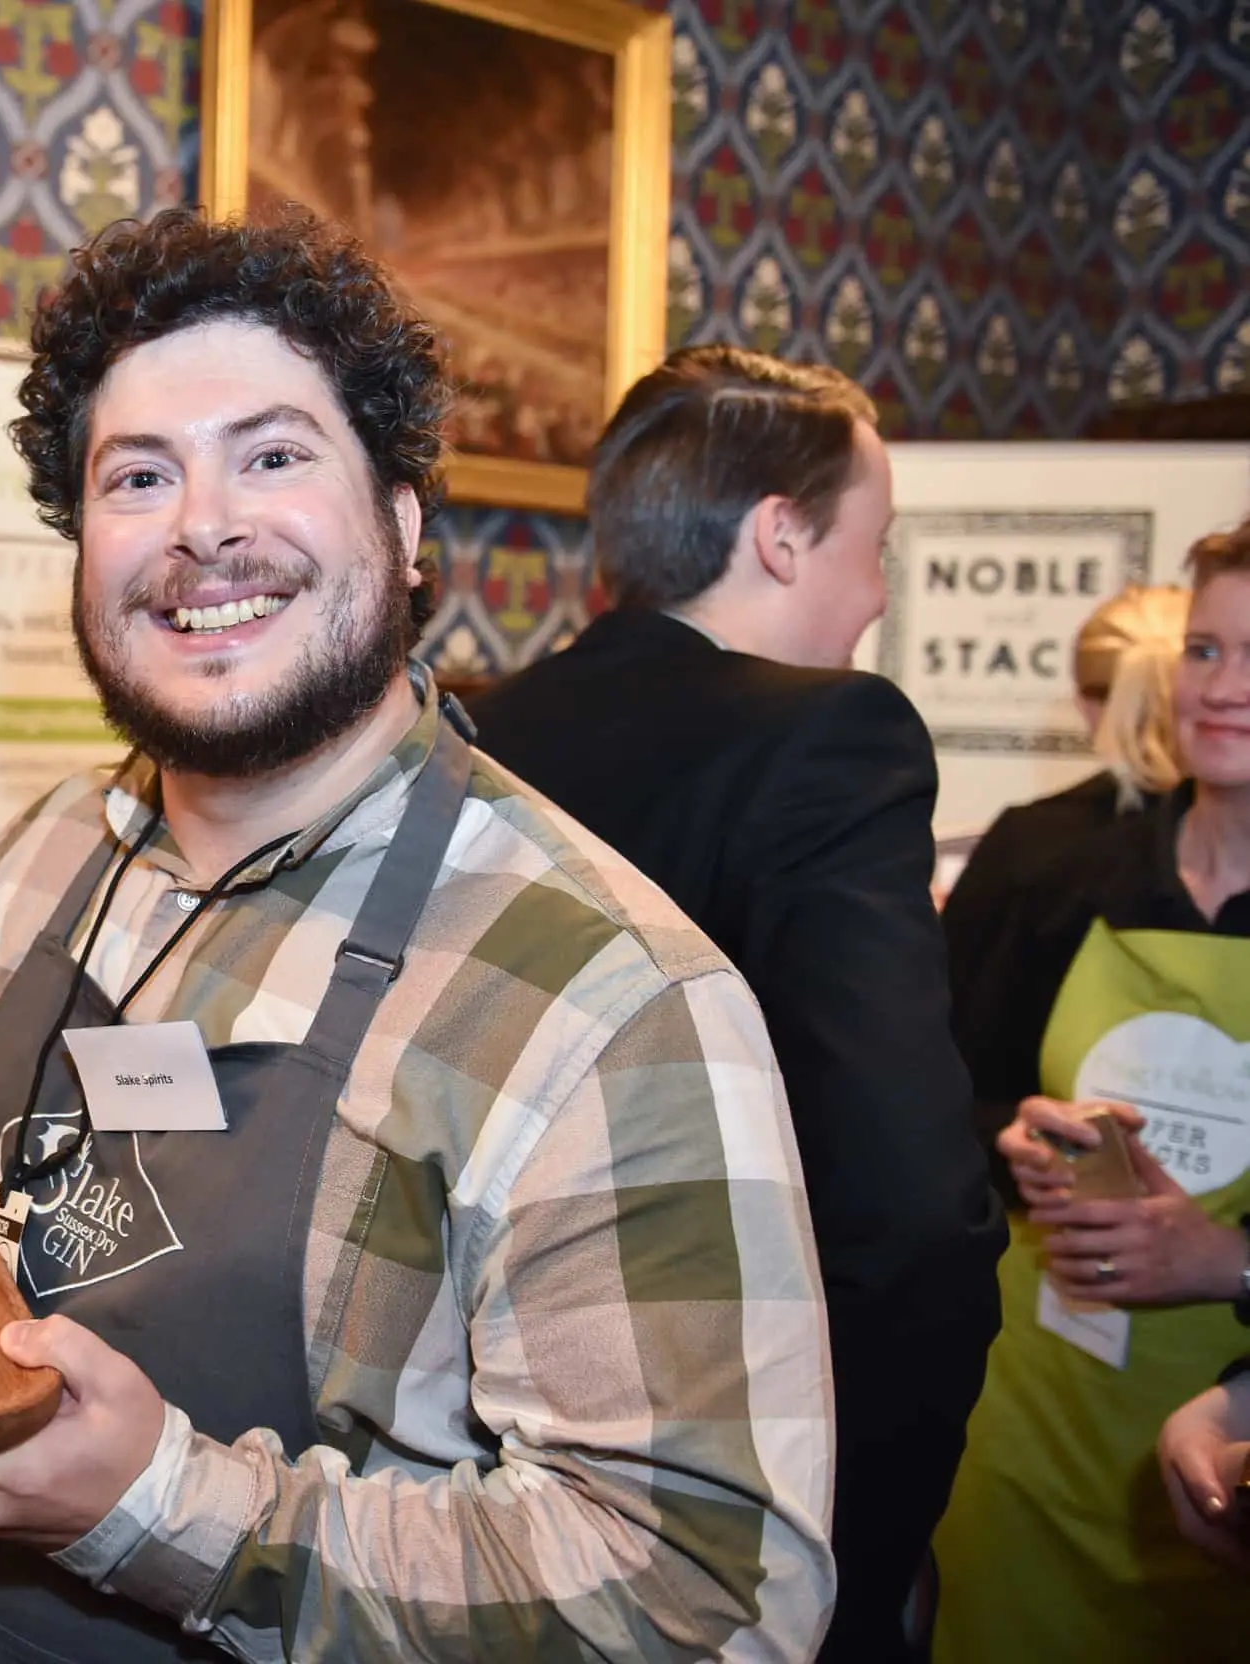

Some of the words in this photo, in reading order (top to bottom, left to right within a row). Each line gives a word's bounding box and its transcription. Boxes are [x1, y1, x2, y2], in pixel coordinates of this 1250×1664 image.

[925, 557, 1101, 595] NOBLE
[923, 638, 1058, 677] STAC
[115, 1074, 141, 1086] Slake
[142, 1073, 174, 1087] Spirits
[42, 1224, 97, 1276] GIN
[56, 1207, 96, 1242] Sussex
[95, 1230, 118, 1256] Dry
